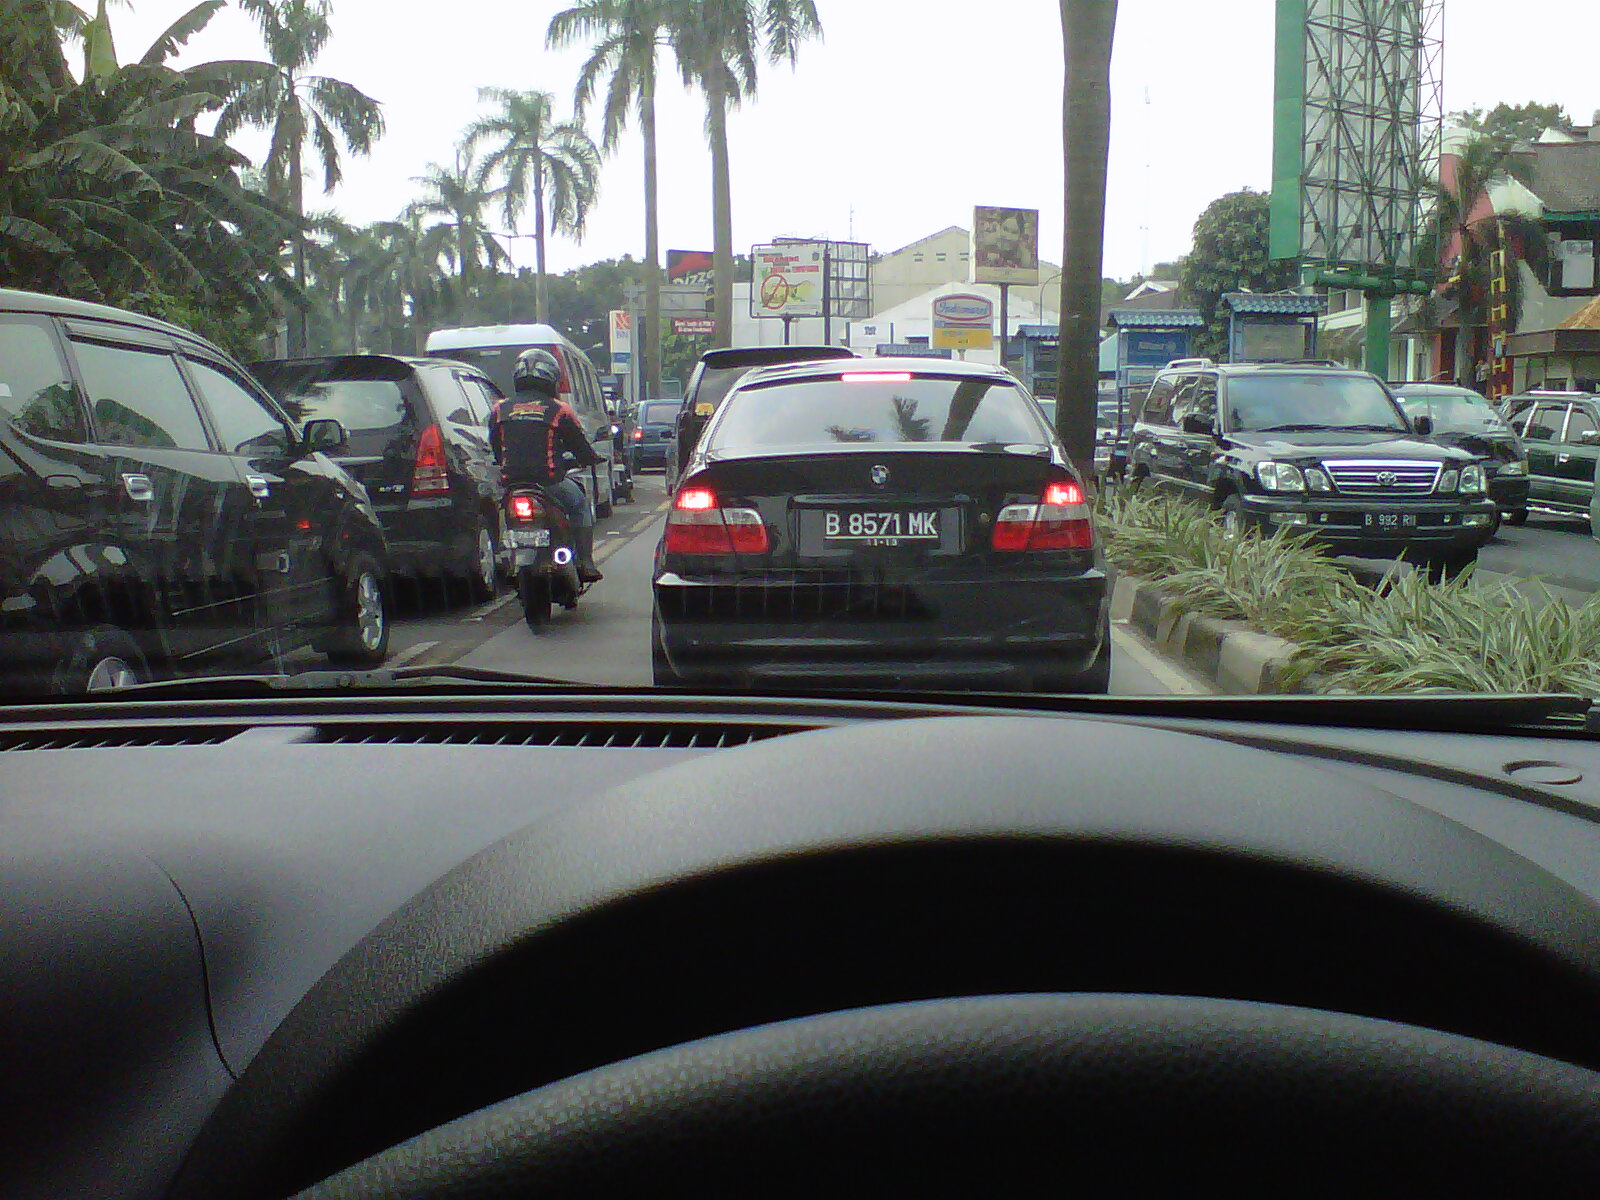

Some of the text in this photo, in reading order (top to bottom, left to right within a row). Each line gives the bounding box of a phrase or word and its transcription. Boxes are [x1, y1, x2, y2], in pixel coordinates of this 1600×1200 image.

[826, 512, 937, 535] B 8571 MK
[1365, 514, 1373, 526] B
[1379, 514, 1398, 526] 992
